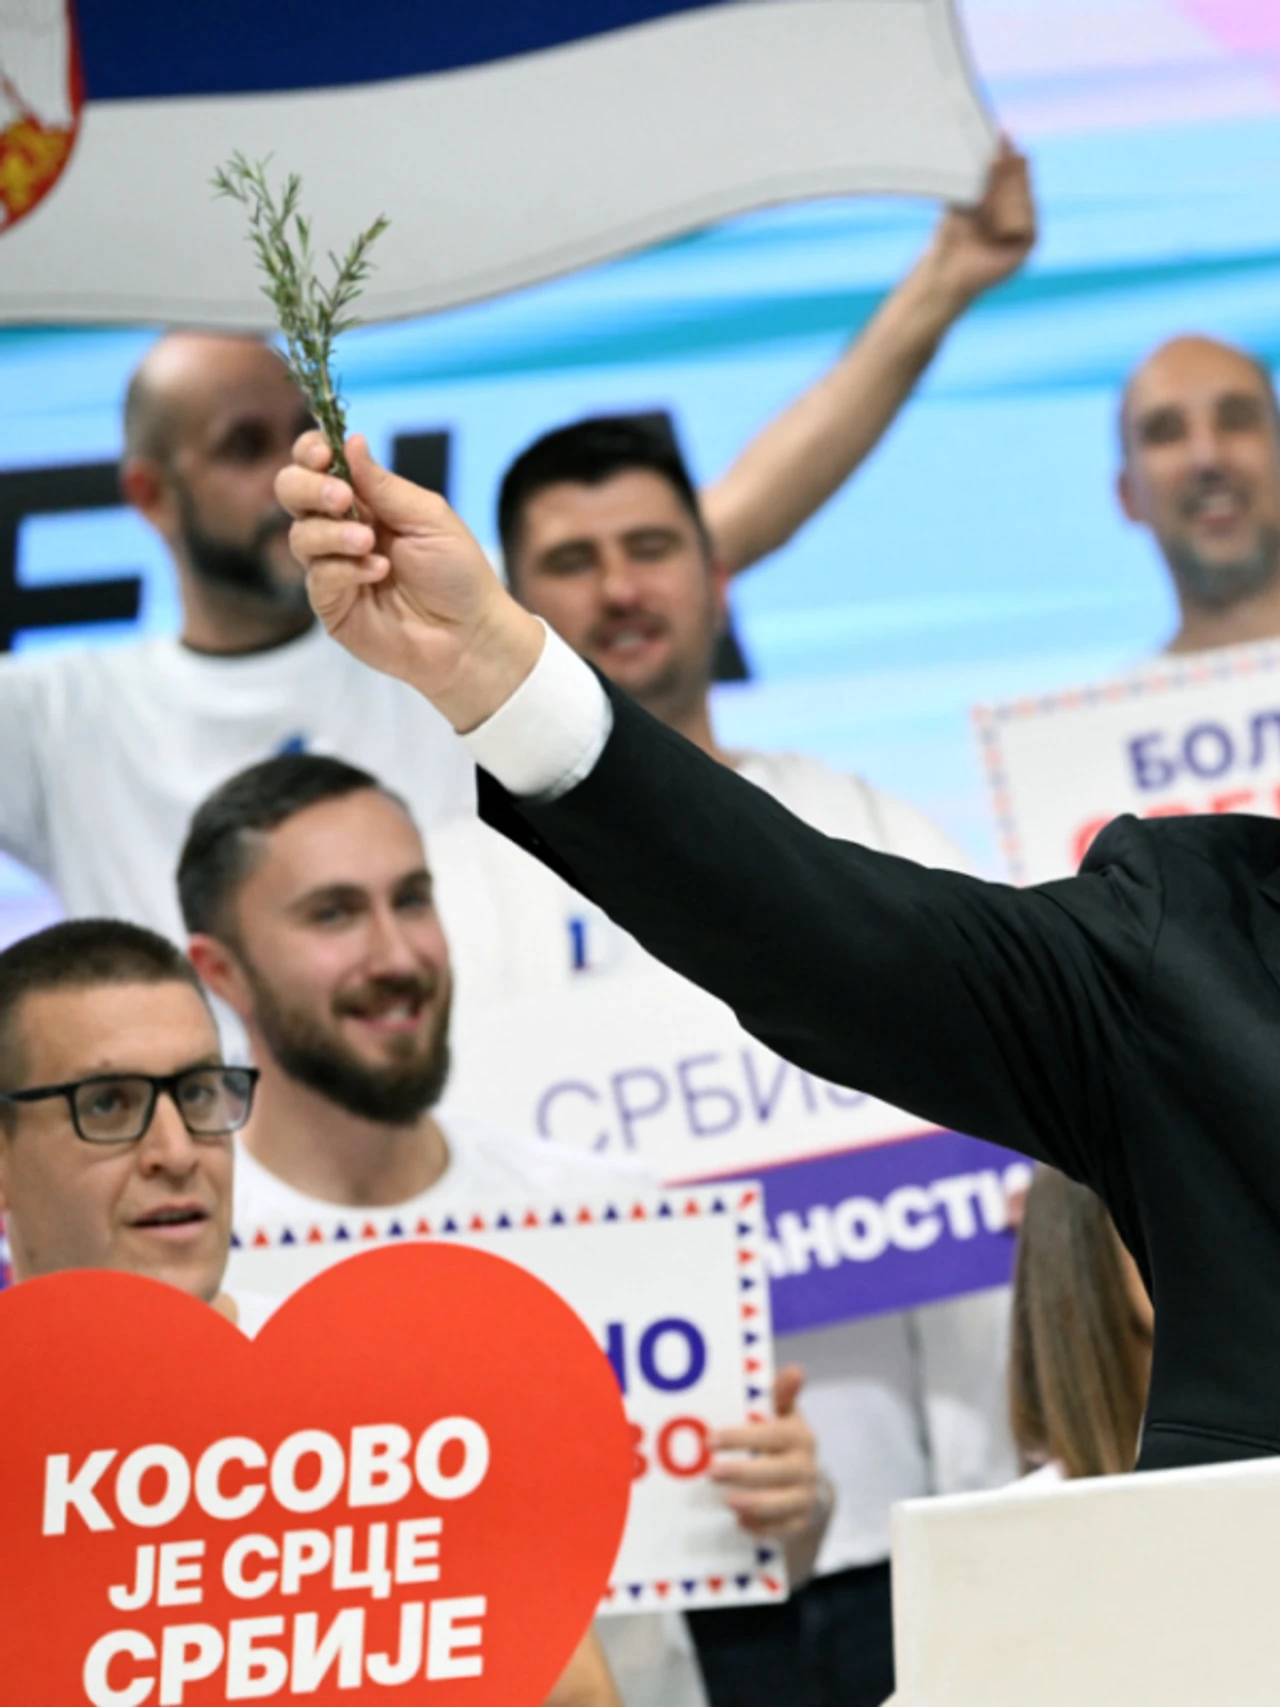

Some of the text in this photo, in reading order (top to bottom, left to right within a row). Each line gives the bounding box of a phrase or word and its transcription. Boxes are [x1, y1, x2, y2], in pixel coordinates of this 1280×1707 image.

[535, 1045, 872, 1154] СРБИ
[42, 1416, 491, 1537] КОСОВО
[108, 1517, 444, 1611] ЈЕ СРЦЕ
[82, 1596, 488, 1707] СРБИЈЕ
